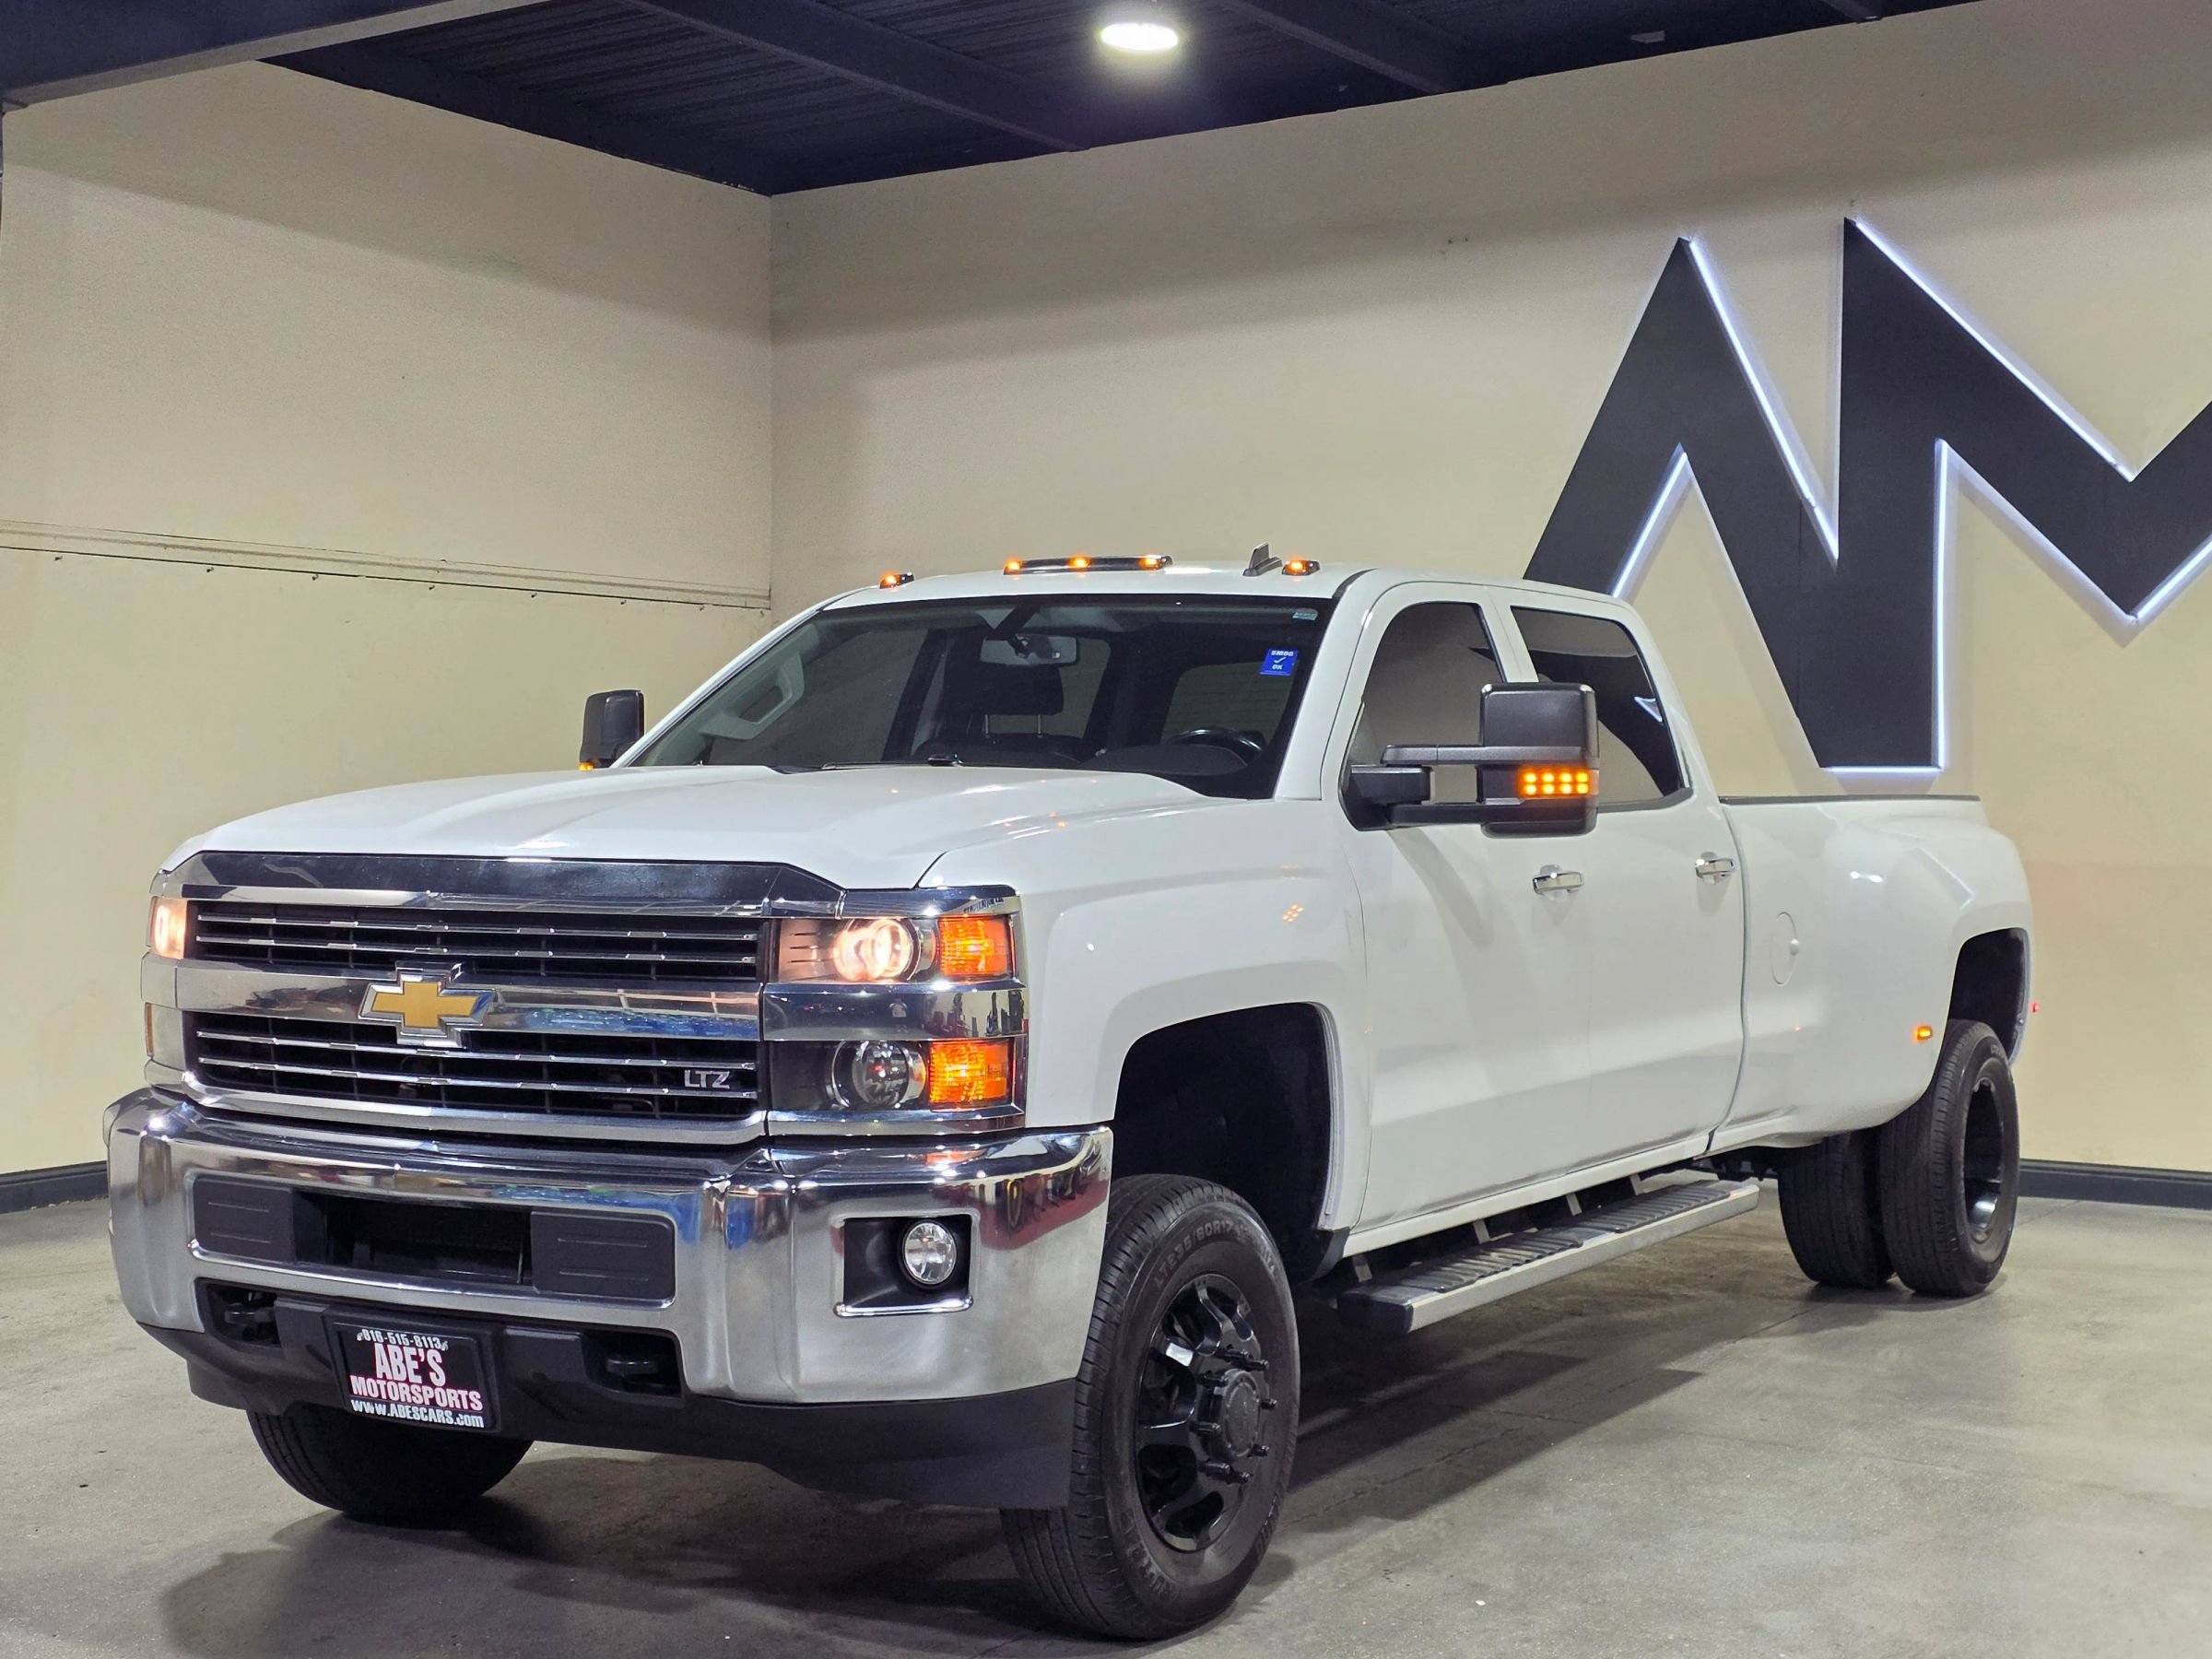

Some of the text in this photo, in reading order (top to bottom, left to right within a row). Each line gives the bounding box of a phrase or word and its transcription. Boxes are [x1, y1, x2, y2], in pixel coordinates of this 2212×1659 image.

[684, 1069, 730, 1088] LTZ
[361, 1328, 442, 1350] 916-515-8113
[374, 1343, 446, 1387] ABE'S
[349, 1375, 484, 1411] MOTORSPORTS
